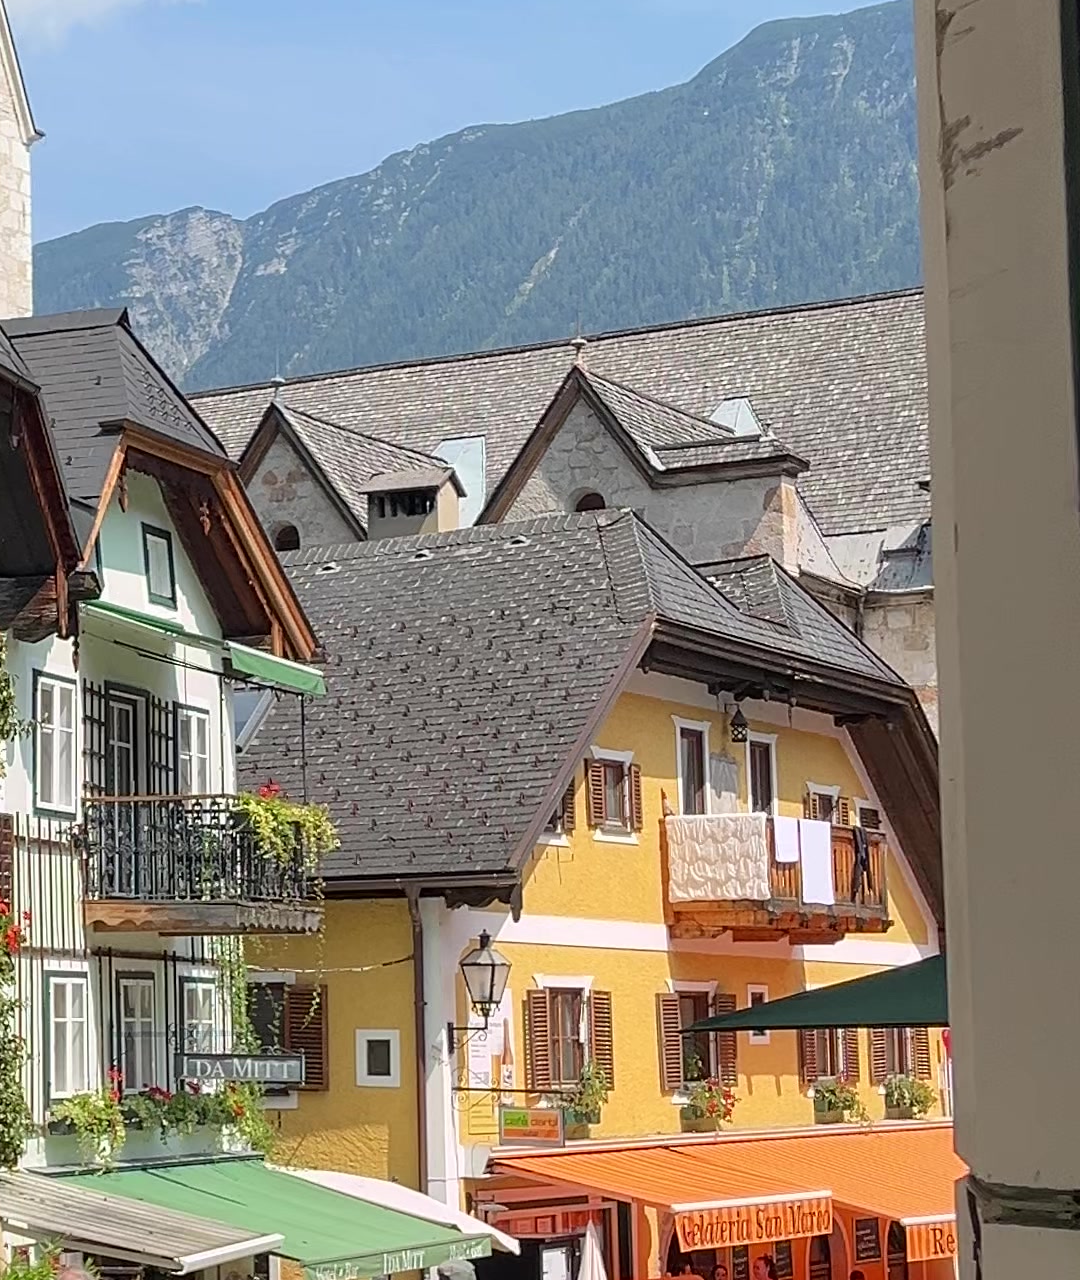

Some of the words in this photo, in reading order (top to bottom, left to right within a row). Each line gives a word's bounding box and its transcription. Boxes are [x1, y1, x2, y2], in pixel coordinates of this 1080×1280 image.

[233, 1058, 294, 1079] MITT
[682, 1211, 749, 1248] Gelateria
[756, 1208, 782, 1239] San
[789, 1205, 830, 1236] Marco
[930, 1227, 956, 1255] Re
[402, 1250, 425, 1272] MITT
